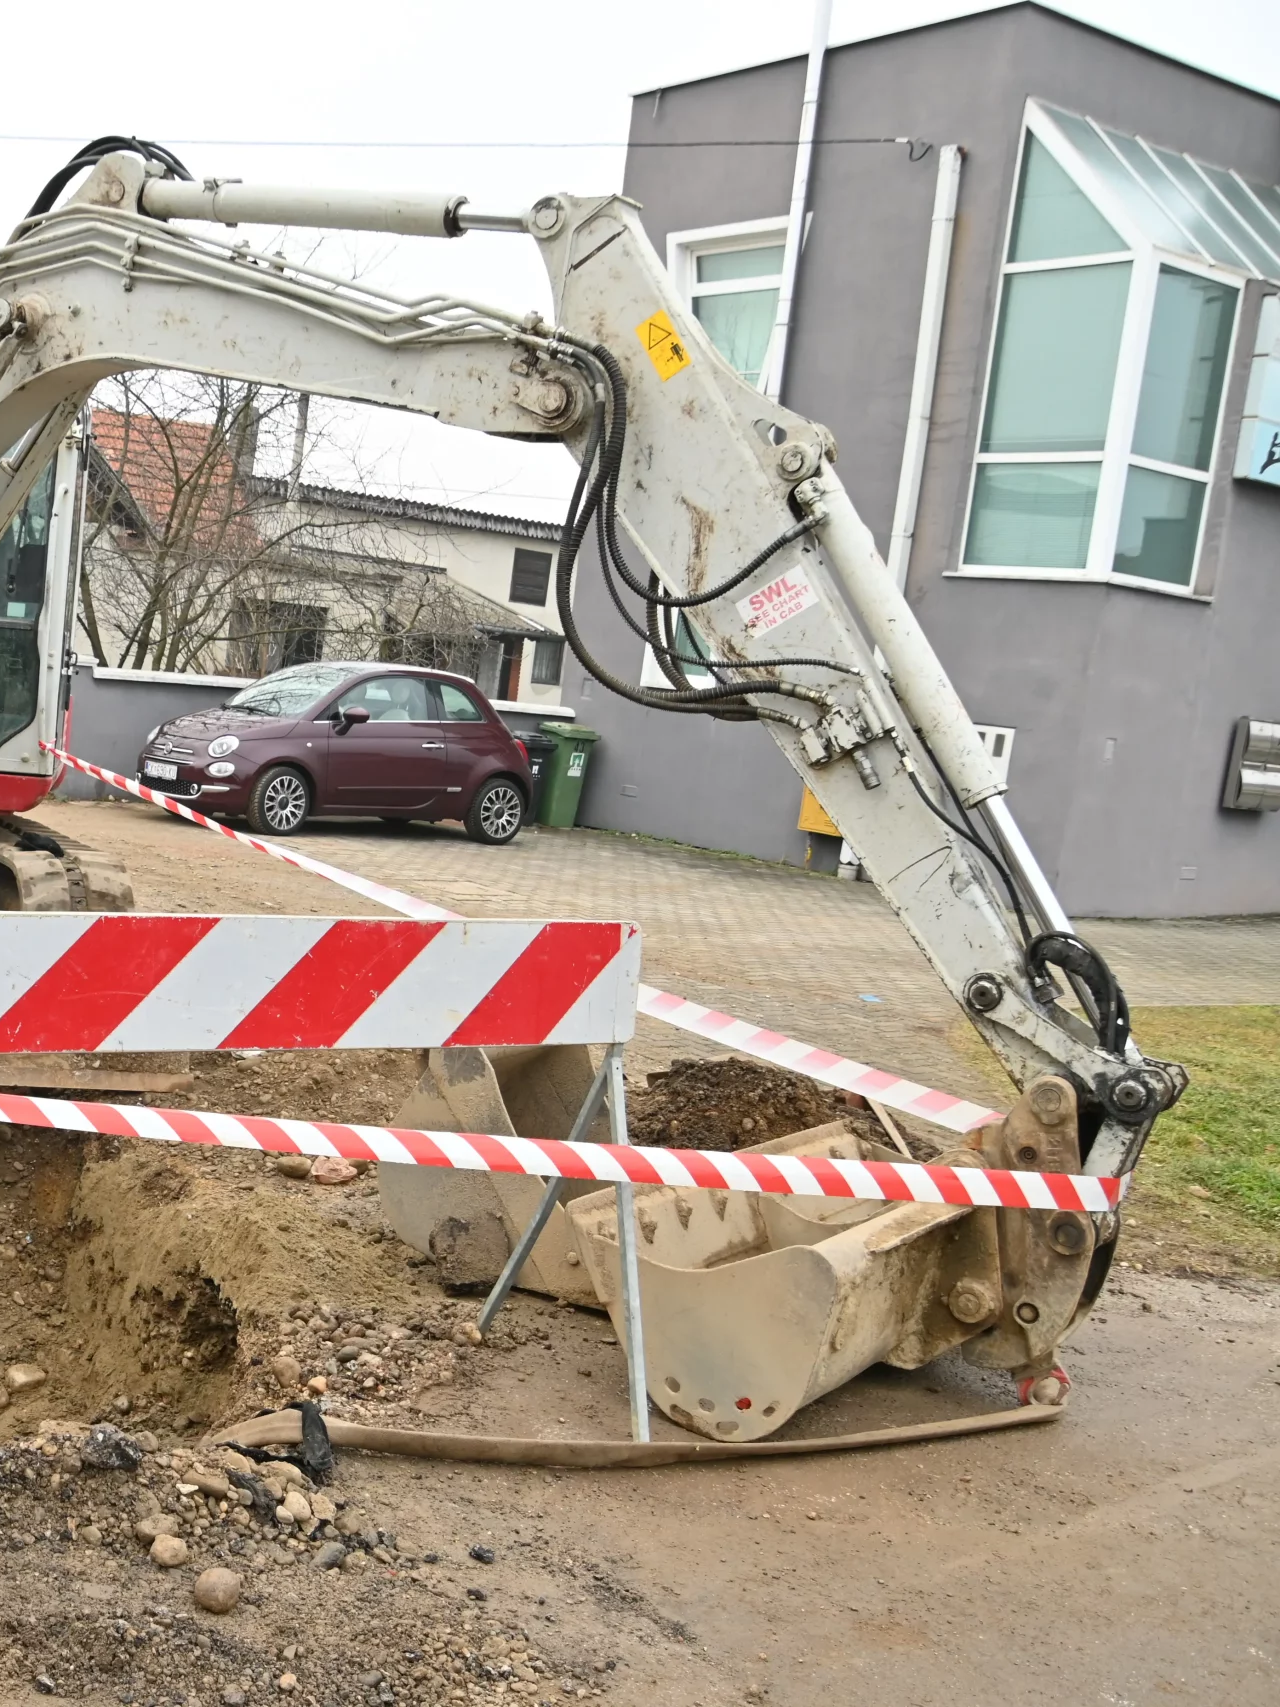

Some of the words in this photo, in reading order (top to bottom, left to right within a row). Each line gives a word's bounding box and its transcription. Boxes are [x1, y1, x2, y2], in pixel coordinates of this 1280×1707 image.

[748, 576, 797, 612] SWL
[748, 609, 770, 627] SEE
[772, 585, 809, 612] CHART
[764, 617, 777, 628] IN
[779, 602, 803, 620] CAB
